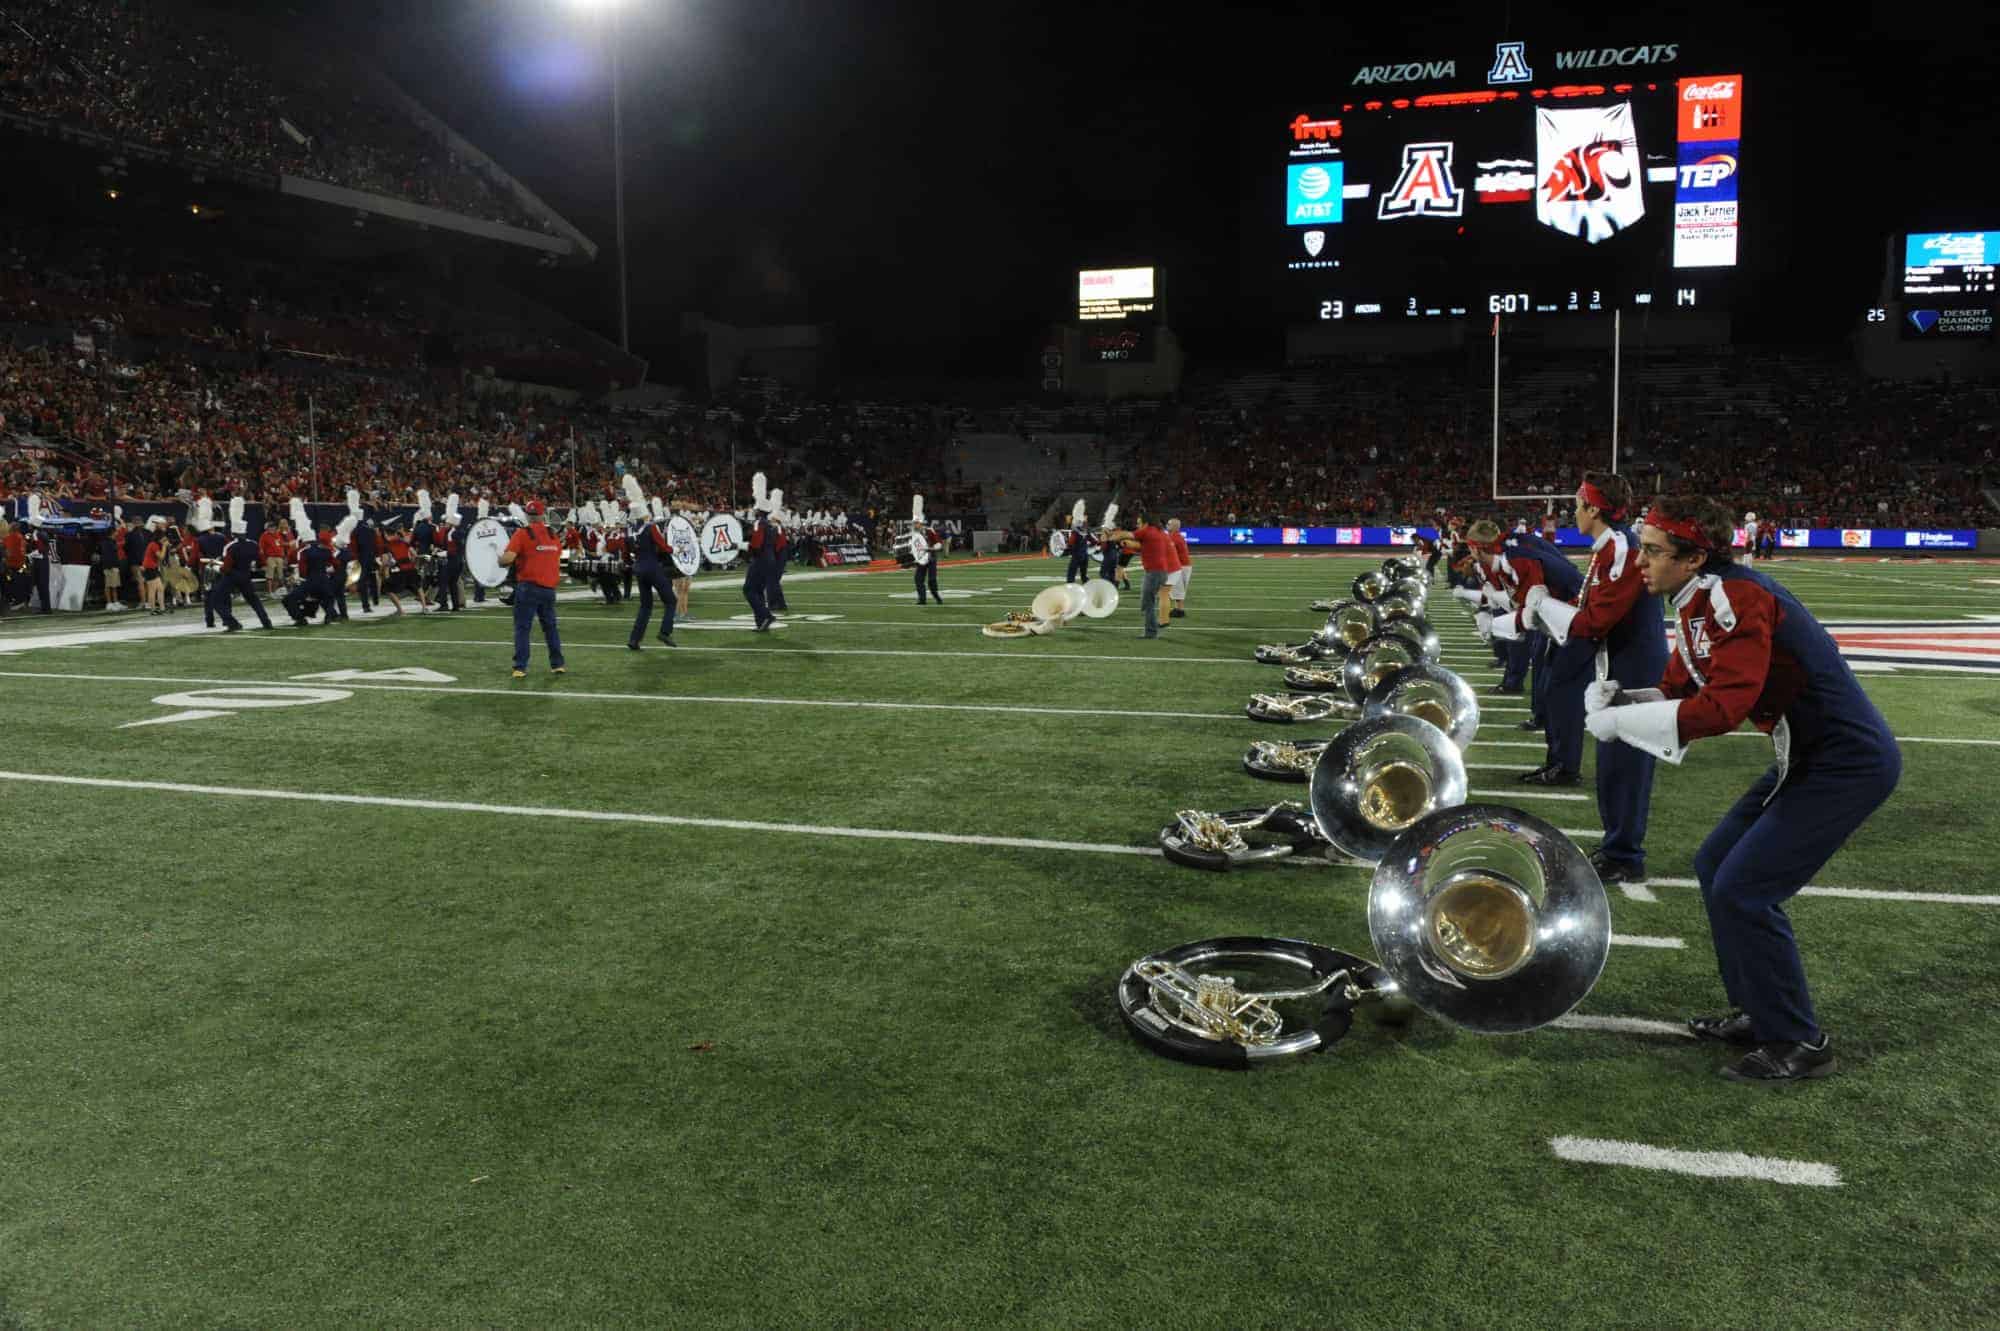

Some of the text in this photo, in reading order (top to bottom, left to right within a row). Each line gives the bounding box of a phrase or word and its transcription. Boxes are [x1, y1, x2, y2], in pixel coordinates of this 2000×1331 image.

[1487, 41, 1533, 84] A
[1555, 44, 1679, 70] WILDCATS
[1352, 60, 1456, 85] ARIZONA
[1377, 141, 1465, 220] A
[1680, 163, 1731, 188] TEP
[1296, 202, 1334, 218] AT&T
[1678, 206, 1700, 217] Jack
[1288, 260, 1340, 269] NETWORKS
[1409, 297, 1417, 309] 3
[1489, 294, 1529, 313] 6:07
[1570, 292, 1577, 303] 3
[1593, 291, 1600, 302] 3
[1677, 289, 1695, 306] 14
[1320, 301, 1343, 319] 23
[1867, 309, 1885, 321] 25
[1943, 309, 1987, 317] DESERT
[710, 524, 734, 554] A
